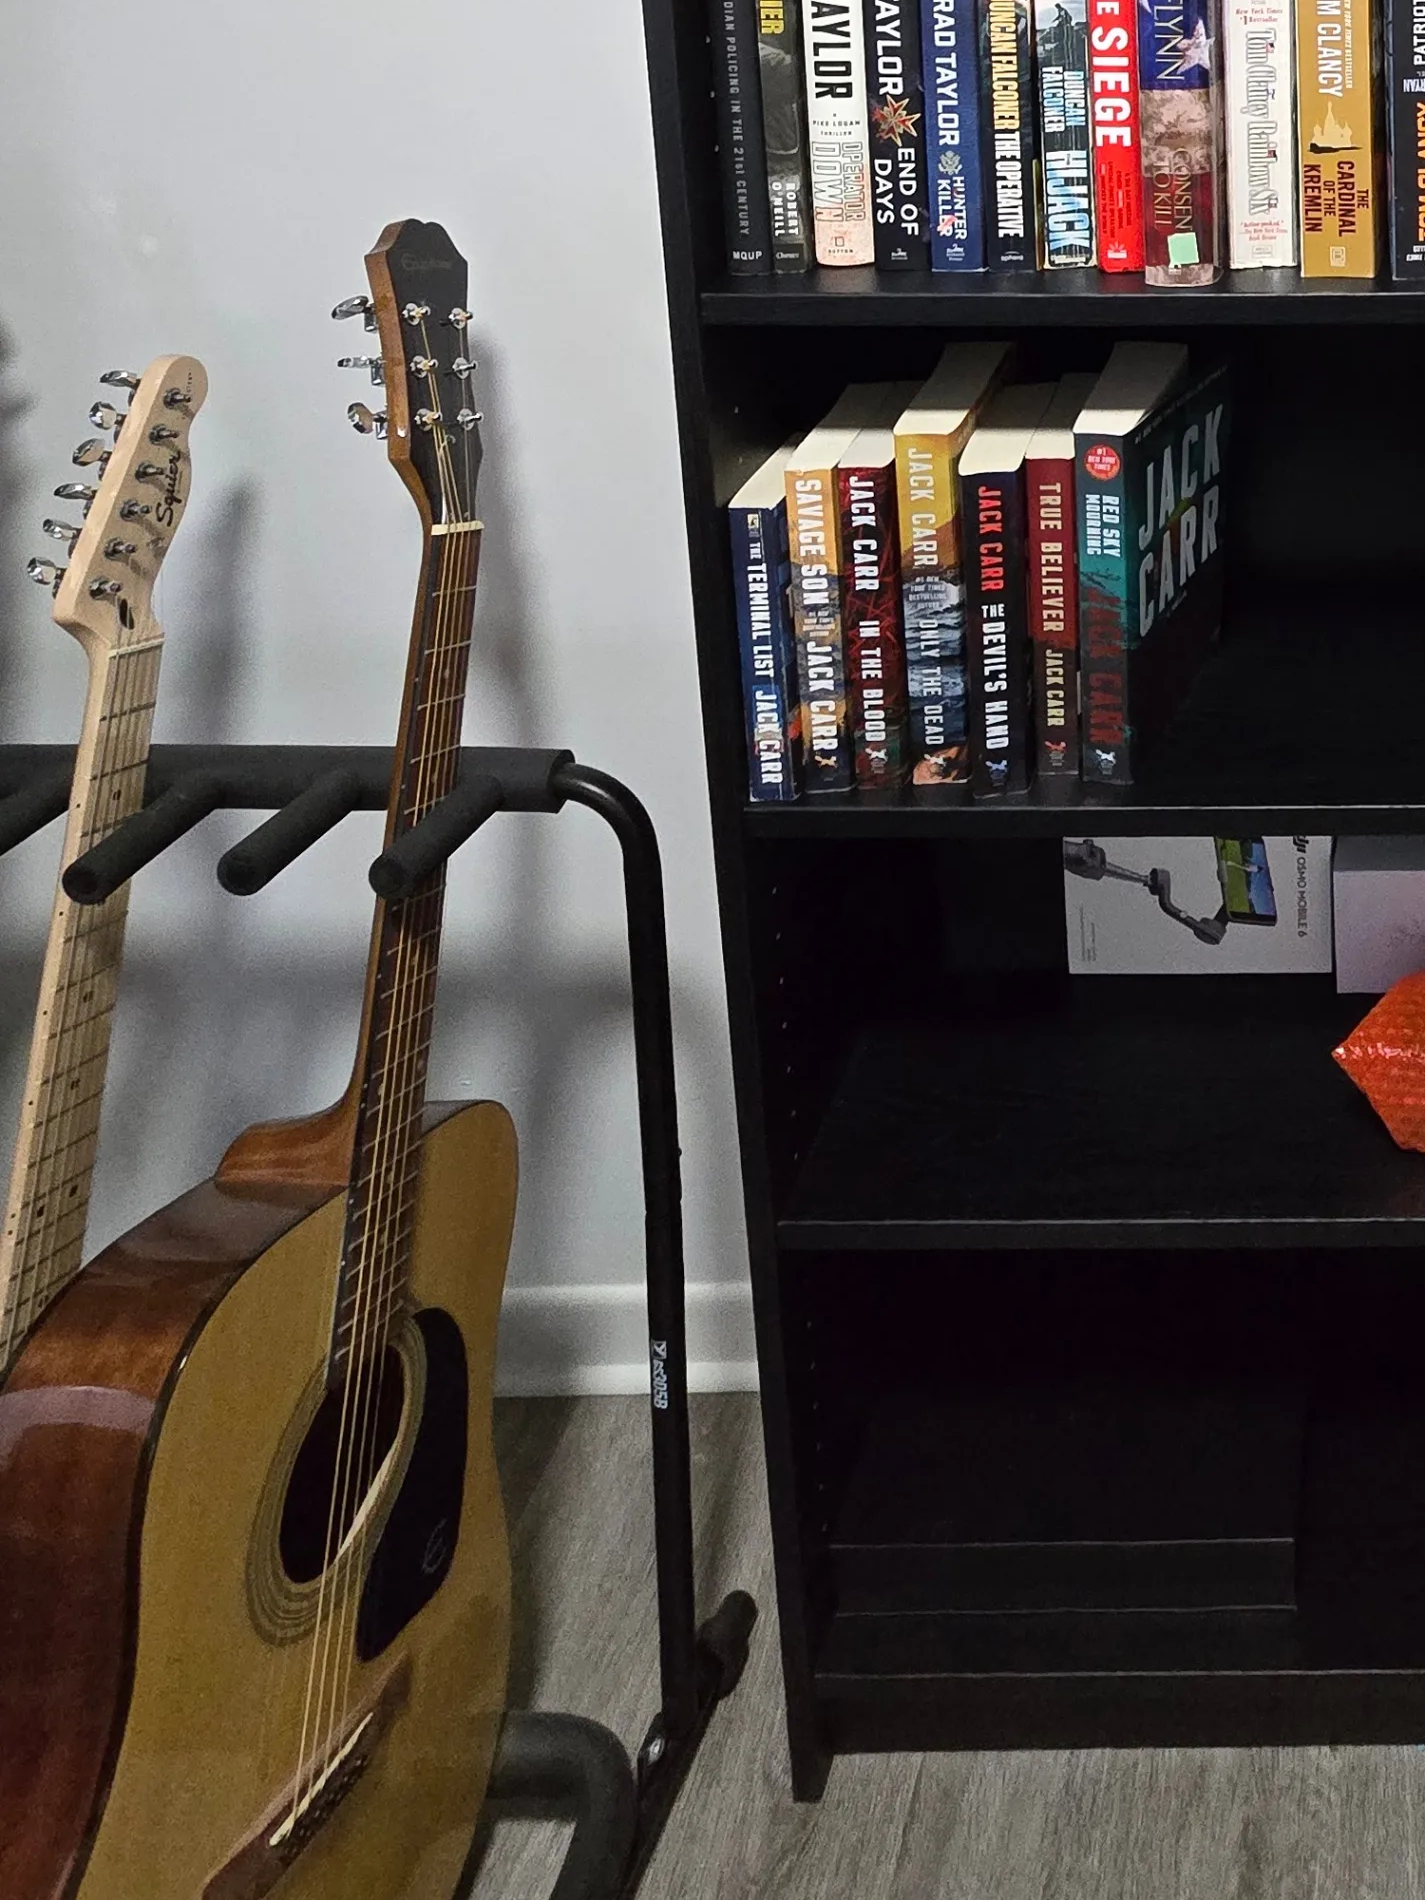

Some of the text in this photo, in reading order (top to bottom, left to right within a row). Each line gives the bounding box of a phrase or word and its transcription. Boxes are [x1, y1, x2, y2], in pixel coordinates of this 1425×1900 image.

[935, 51, 960, 146] TAYLOR
[1092, 29, 1131, 148] SIEGE
[1317, 21, 1342, 97] CLANCY
[875, 160, 894, 225] DAYS
[898, 149, 919, 236] END OF
[1303, 164, 1323, 234] KREMLIN
[1337, 160, 1356, 238] CARDINAL
[1357, 189, 1369, 209] THE
[733, 250, 763, 260] MQUP
[155, 447, 182, 527] Squier
[1138, 405, 1223, 551] JACK
[849, 475, 885, 742] JACK CARR IN THE BLOOD
[908, 449, 944, 745] JACK CARR ONLY THE DEAD
[978, 486, 1009, 749] JACK CARR THE DEVIL'S HAND
[1040, 483, 1064, 726] TRUE BELIEVER JACK CARR
